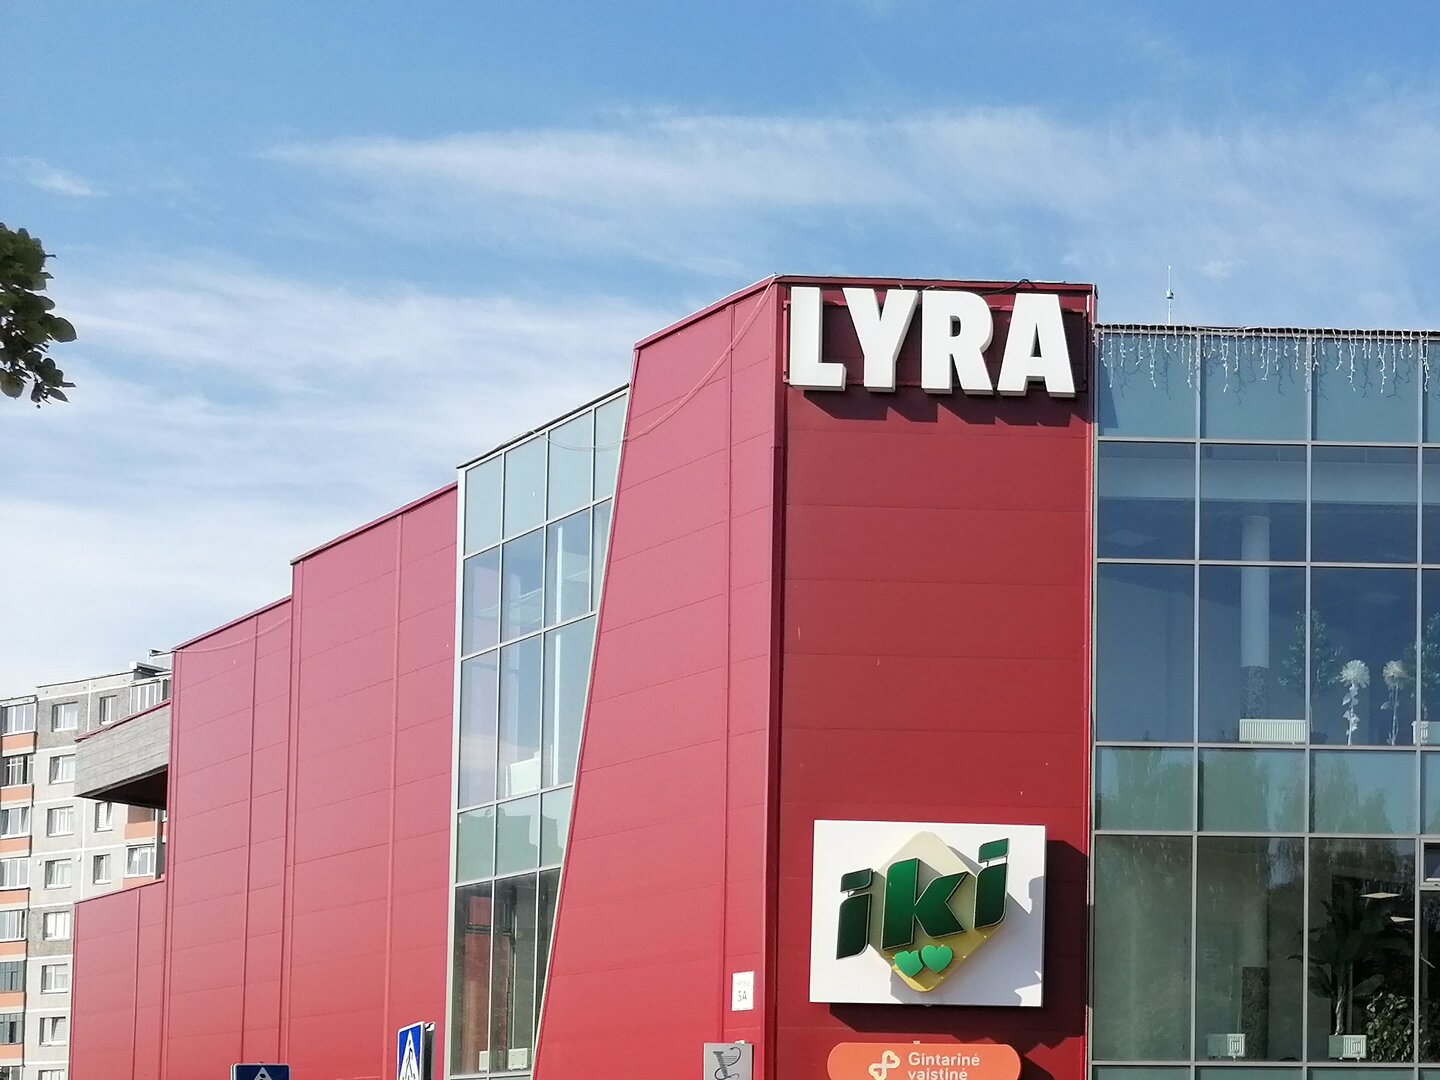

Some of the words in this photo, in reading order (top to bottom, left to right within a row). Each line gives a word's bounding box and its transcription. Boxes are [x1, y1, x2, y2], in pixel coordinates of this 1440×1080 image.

[789, 286, 1076, 398] LYRA
[836, 837, 1010, 960] iki
[907, 1068, 968, 1080] vaistinė
[908, 1052, 980, 1066] Gintarinė
